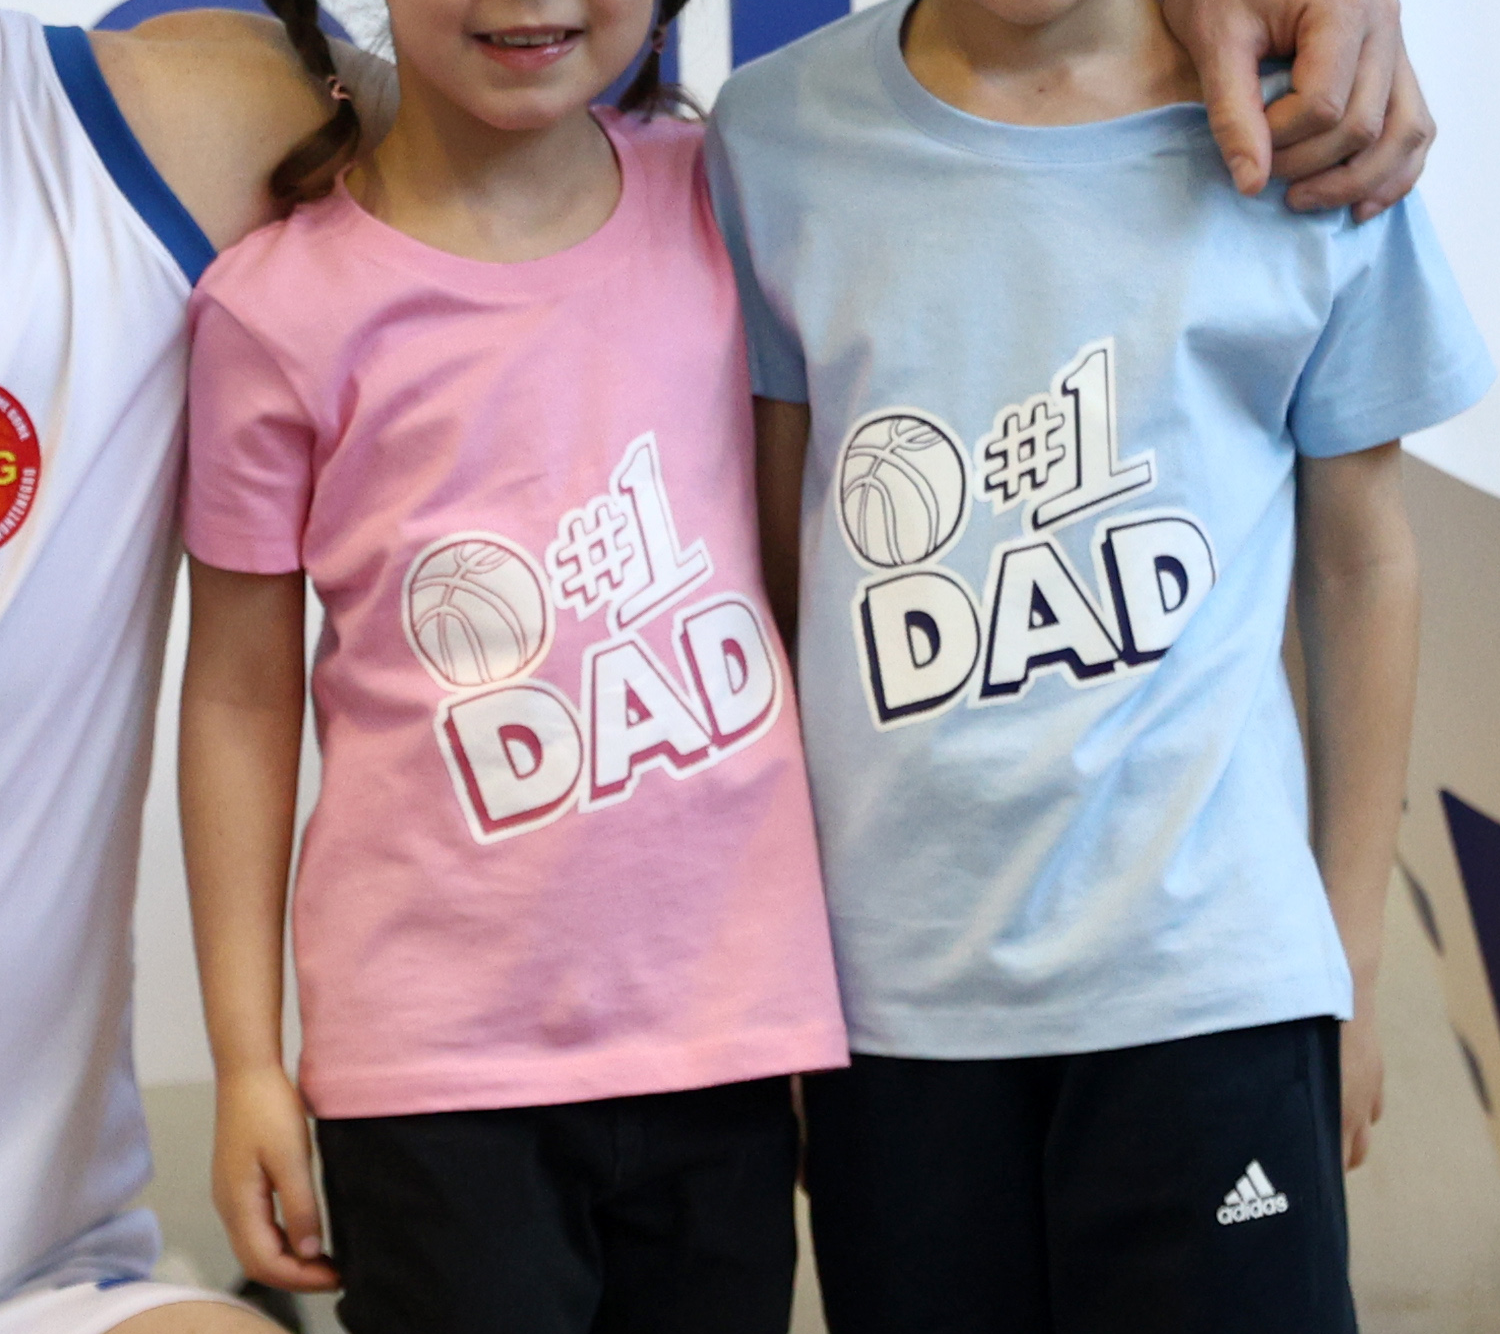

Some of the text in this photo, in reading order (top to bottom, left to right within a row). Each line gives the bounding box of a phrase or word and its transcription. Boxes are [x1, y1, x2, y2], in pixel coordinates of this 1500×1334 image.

[554, 435, 712, 631] #1
[978, 340, 1158, 532] #1
[853, 508, 1216, 729] DAD
[434, 590, 783, 844] DAD
[1216, 1192, 1289, 1225] adidas
